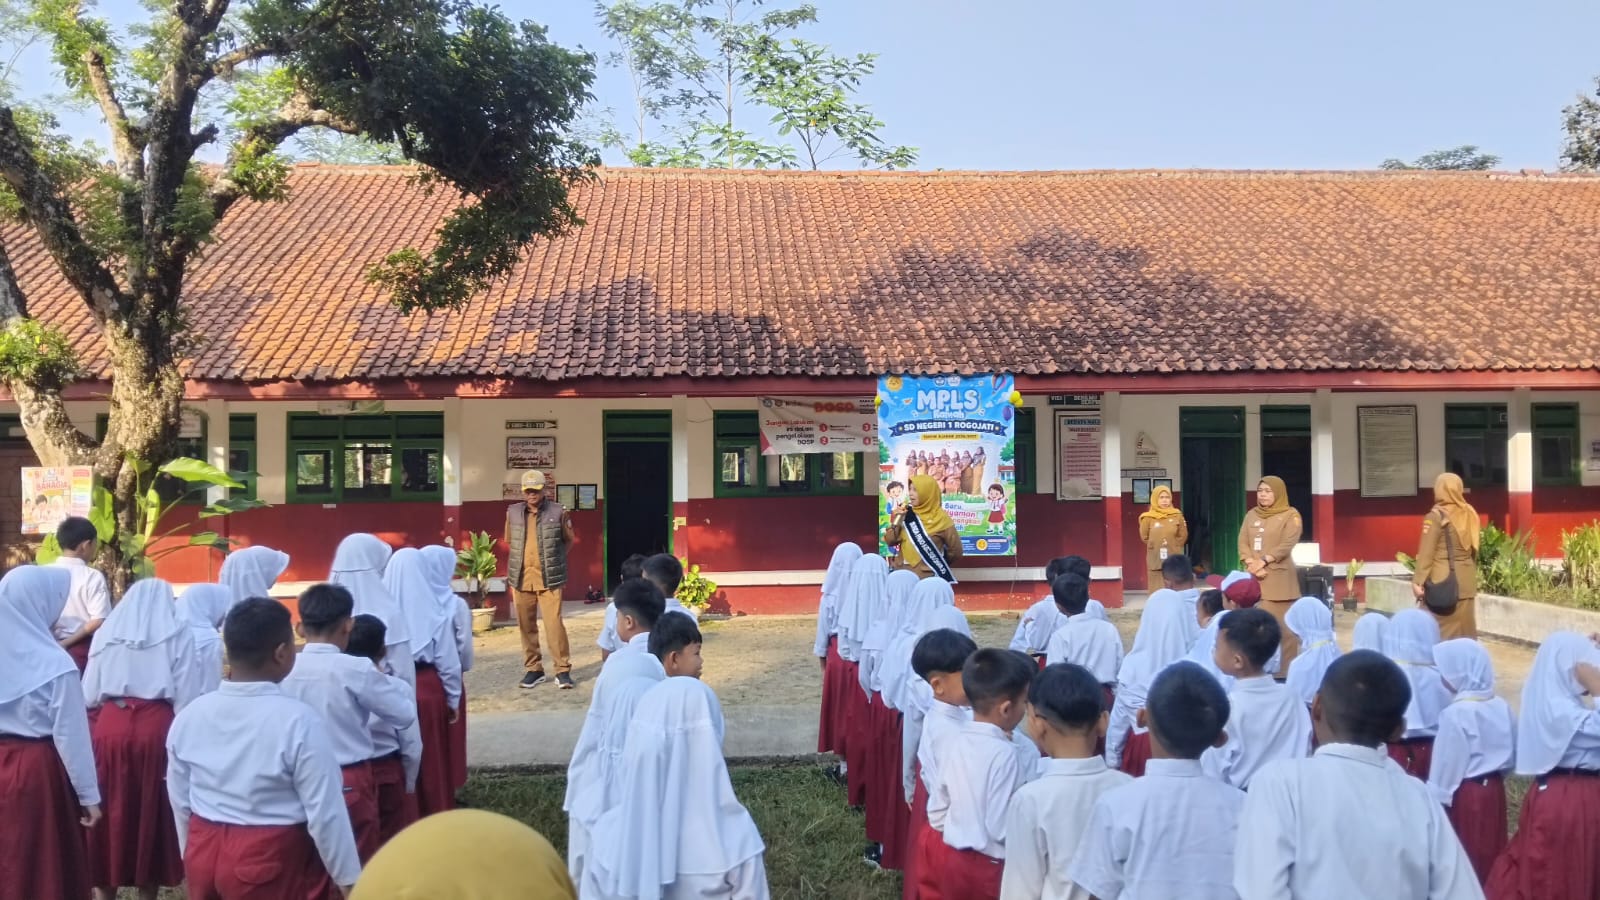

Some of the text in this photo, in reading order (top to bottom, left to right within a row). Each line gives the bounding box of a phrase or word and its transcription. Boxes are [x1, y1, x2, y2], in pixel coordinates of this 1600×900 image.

[917, 389, 978, 410] MPLS
[904, 423, 915, 431] SD
[917, 422, 946, 431] NEGERI
[955, 422, 994, 431] ROGOJATI
